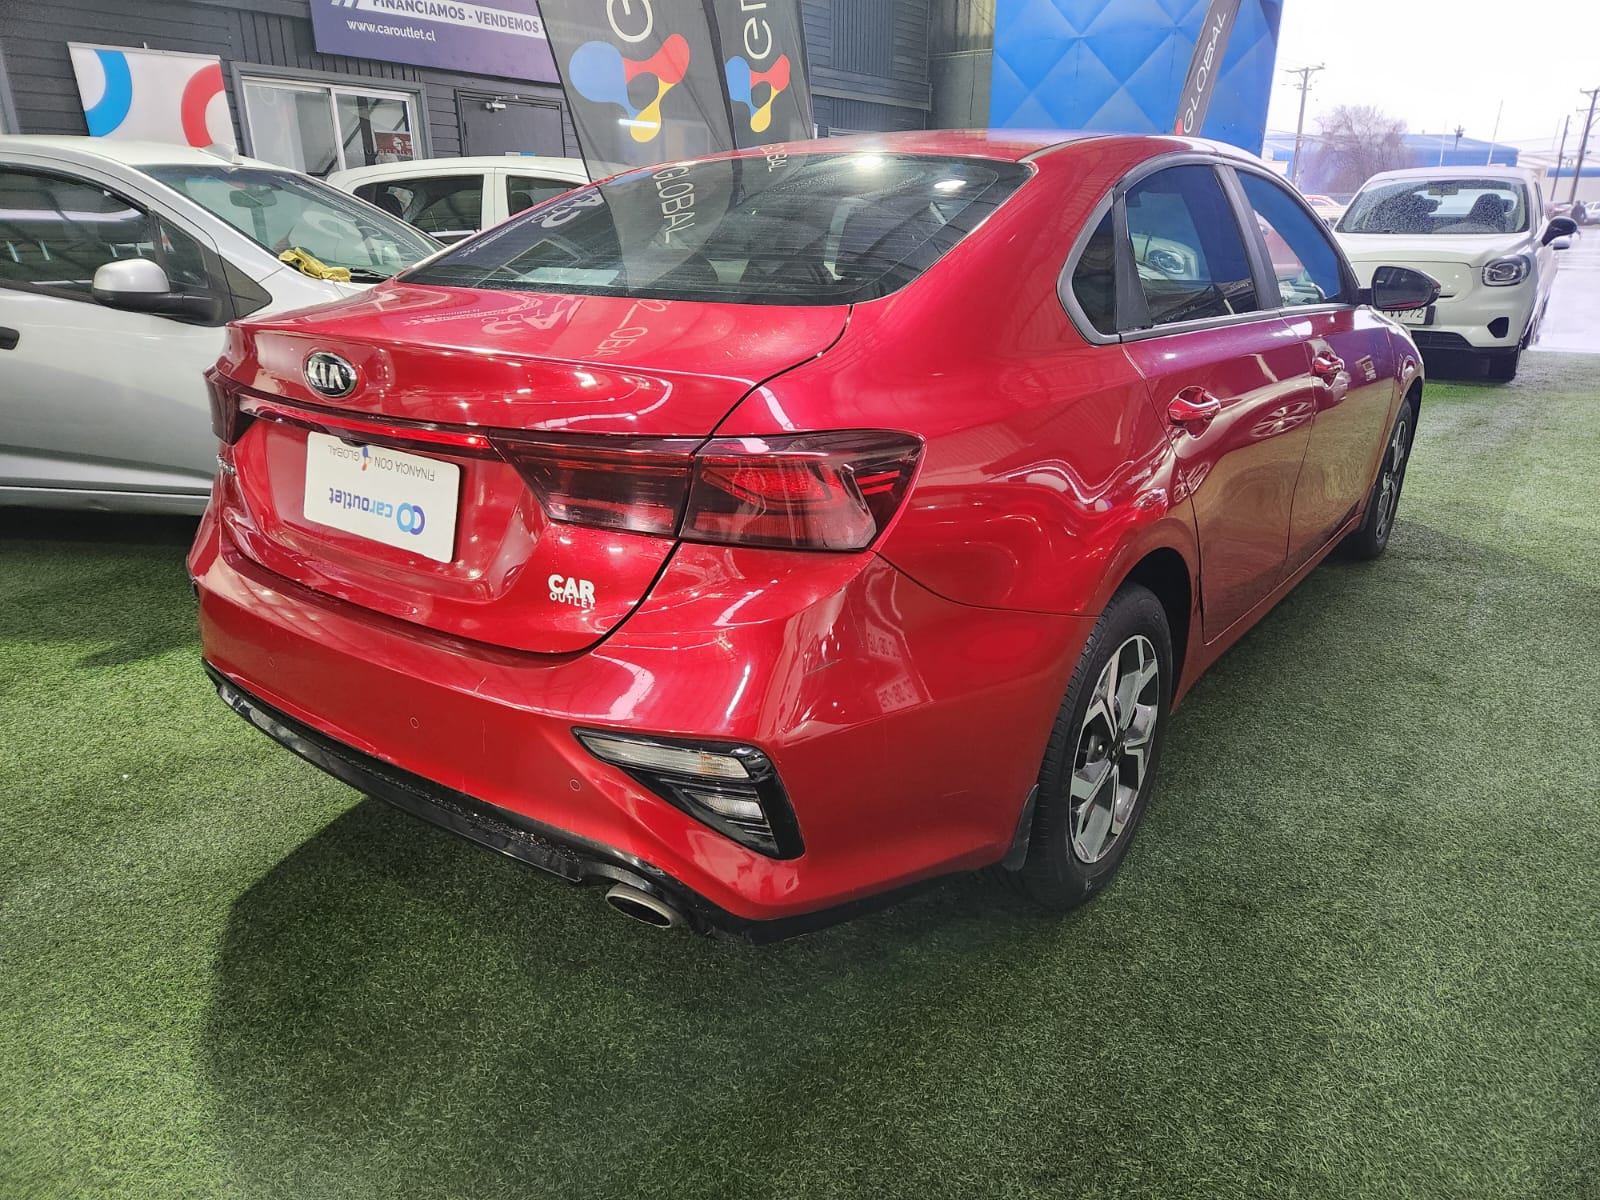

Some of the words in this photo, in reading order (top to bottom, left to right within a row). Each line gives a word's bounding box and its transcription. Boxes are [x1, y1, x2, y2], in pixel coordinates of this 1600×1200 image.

[346, 20, 437, 42] www.caroutlet.cl
[475, 10, 540, 34] VENDEMOS
[1183, 13, 1226, 134] GLOBAL
[307, 360, 346, 391] KIA
[327, 444, 361, 462] GLOBAL
[374, 456, 394, 472] CON
[395, 460, 436, 482] FINANCIA
[329, 487, 394, 519] caroutlet
[548, 574, 596, 604] CAR
[549, 592, 596, 610] OUTLET
